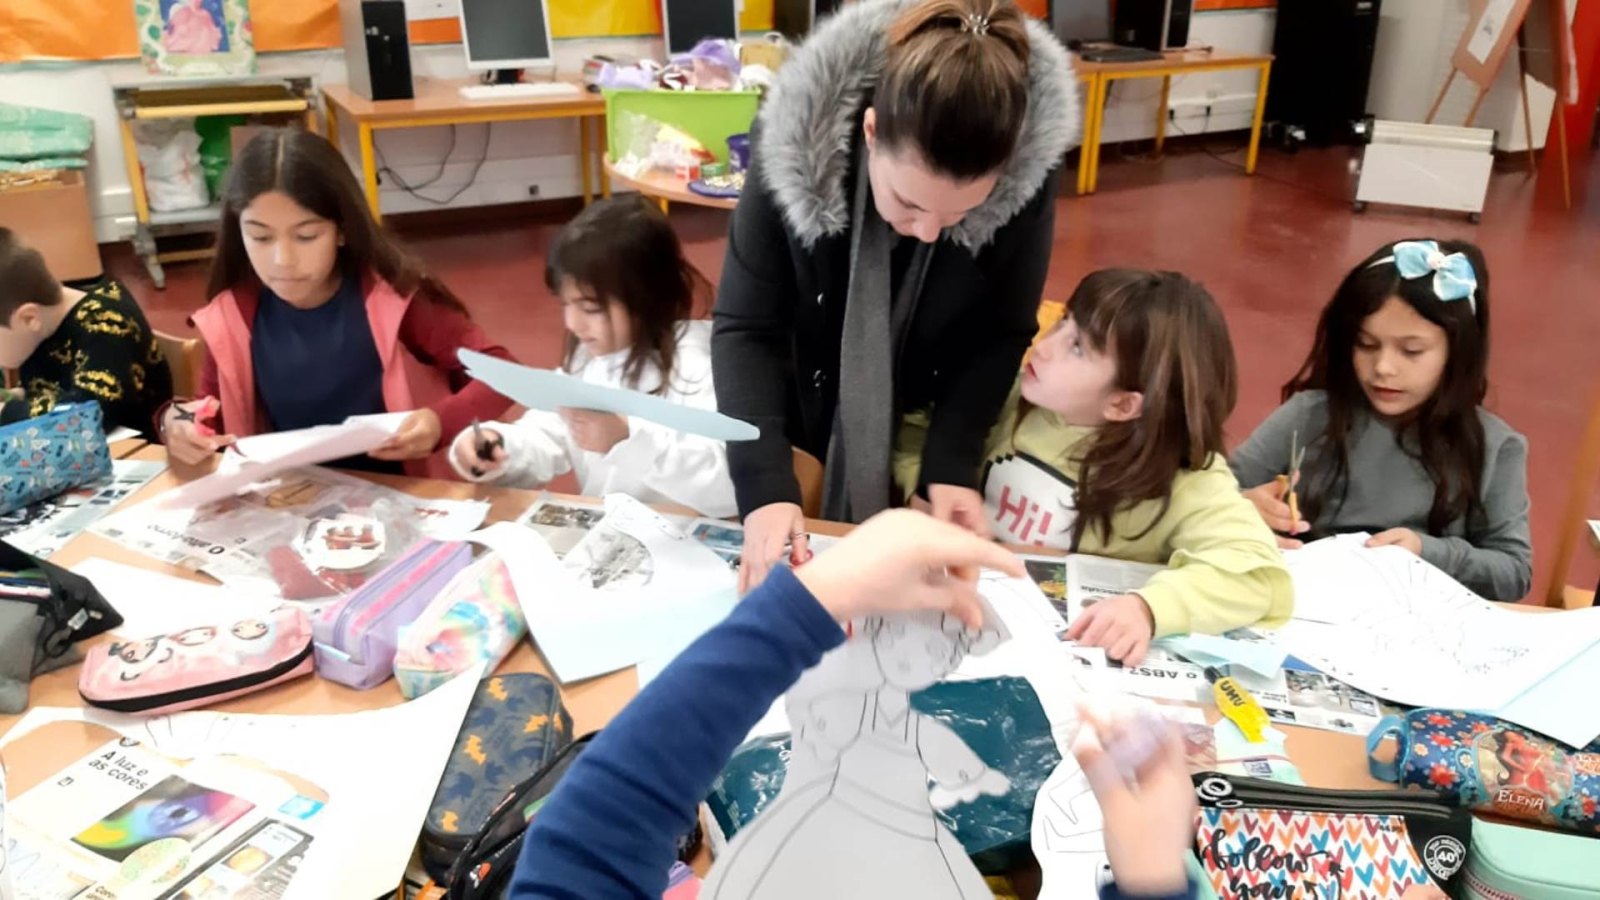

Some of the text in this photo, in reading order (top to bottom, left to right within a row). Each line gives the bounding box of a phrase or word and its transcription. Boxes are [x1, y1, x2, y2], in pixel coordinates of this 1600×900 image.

[994, 485, 1053, 547] Hi!
[1129, 667, 1178, 679] ABS?
[1219, 680, 1246, 707] UHU
[88, 759, 148, 790] as cores
[101, 750, 149, 777] A luz e
[1497, 789, 1545, 811] ELENA
[1437, 850, 1457, 864] 40
